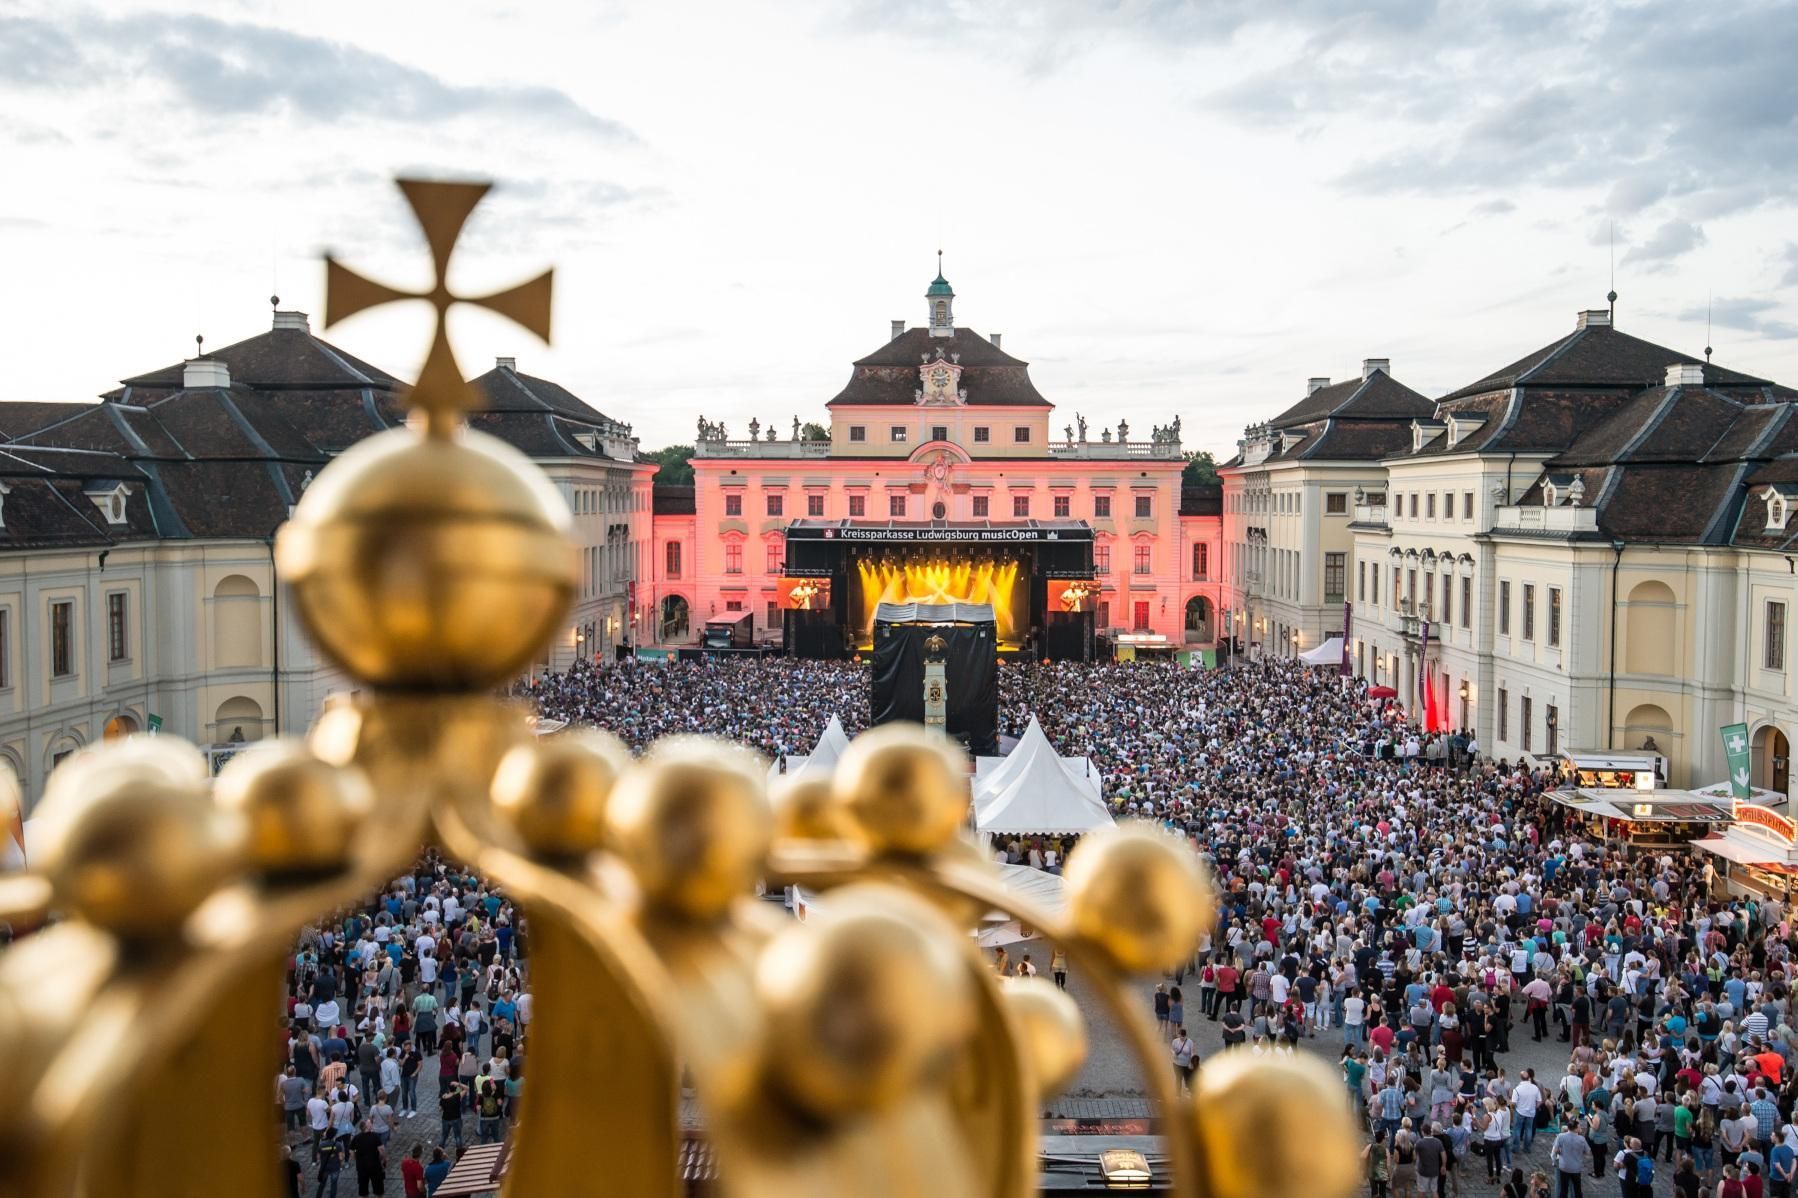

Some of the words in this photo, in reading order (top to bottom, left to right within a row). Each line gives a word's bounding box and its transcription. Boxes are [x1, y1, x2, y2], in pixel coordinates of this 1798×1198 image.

[841, 529, 914, 540] Kreissparkasse
[916, 530, 979, 540] Ludwigsburg
[981, 530, 1038, 540] musicOpen
[1741, 808, 1790, 838] Grill-Station
